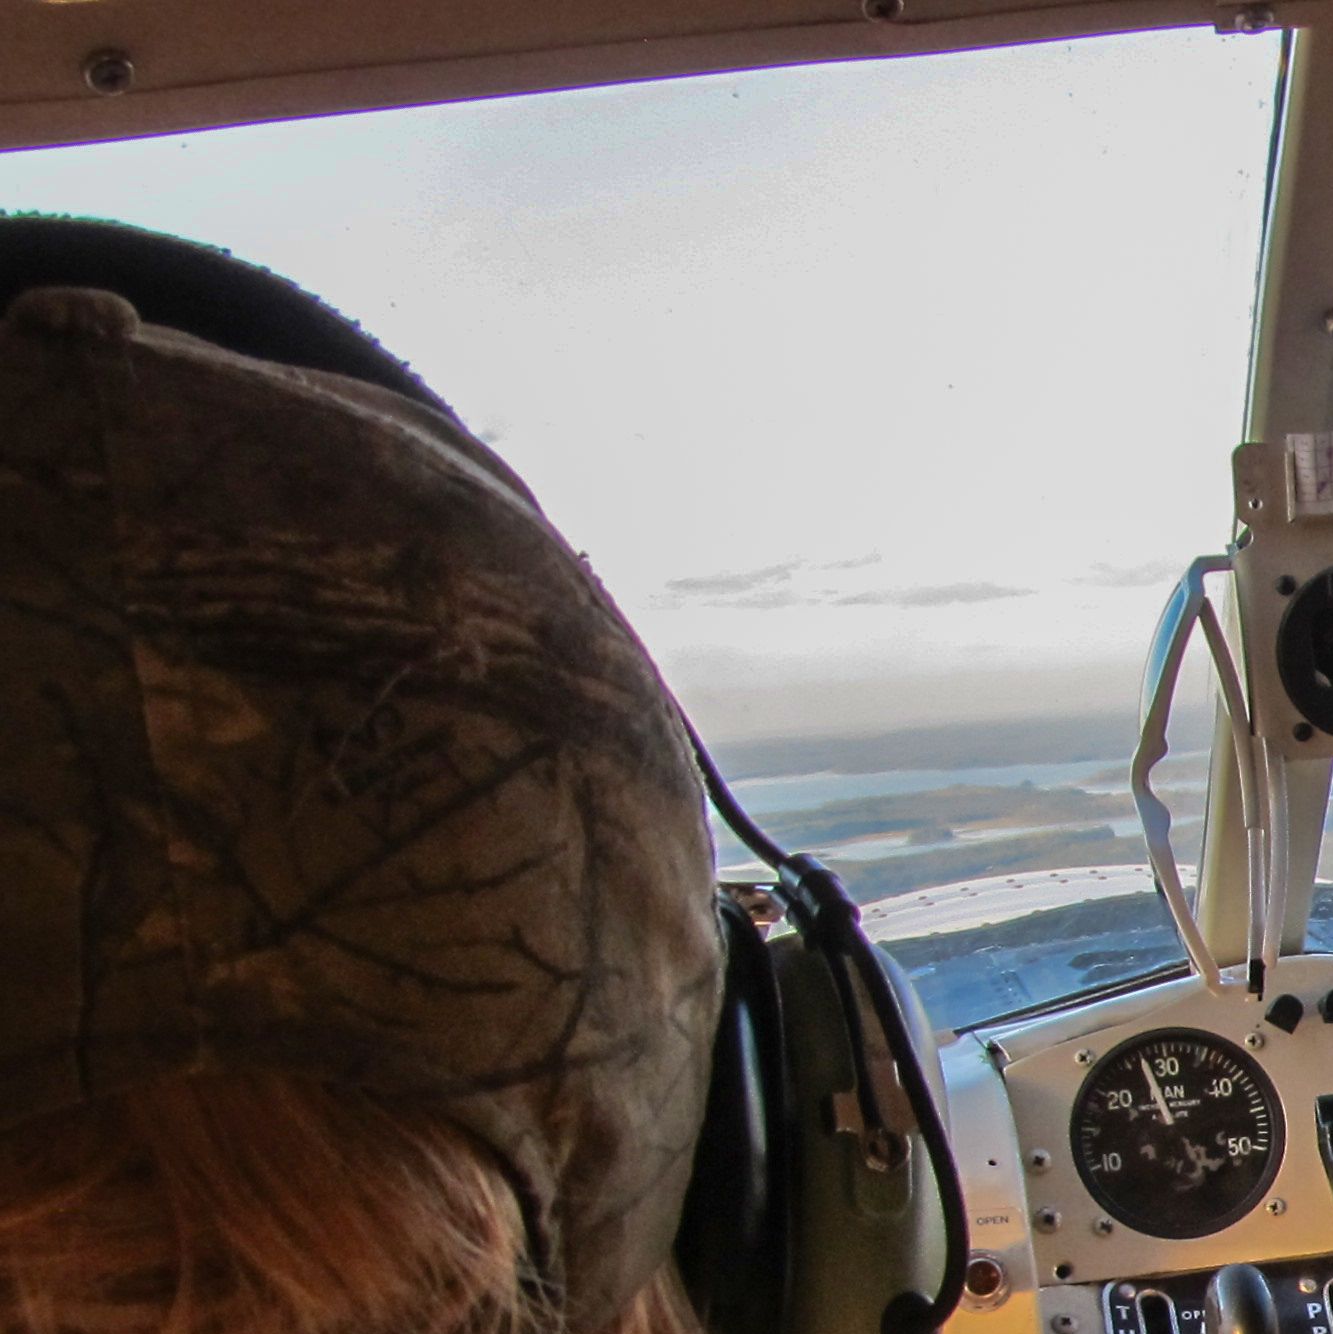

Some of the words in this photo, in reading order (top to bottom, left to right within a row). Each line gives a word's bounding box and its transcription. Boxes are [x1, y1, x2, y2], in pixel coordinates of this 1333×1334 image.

[1155, 1056, 1179, 1077] 30
[1107, 1089, 1132, 1110] 20
[1228, 1136, 1251, 1156] 50
[1102, 1152, 1122, 1171] 10
[976, 1215, 1009, 1226] OPEN
